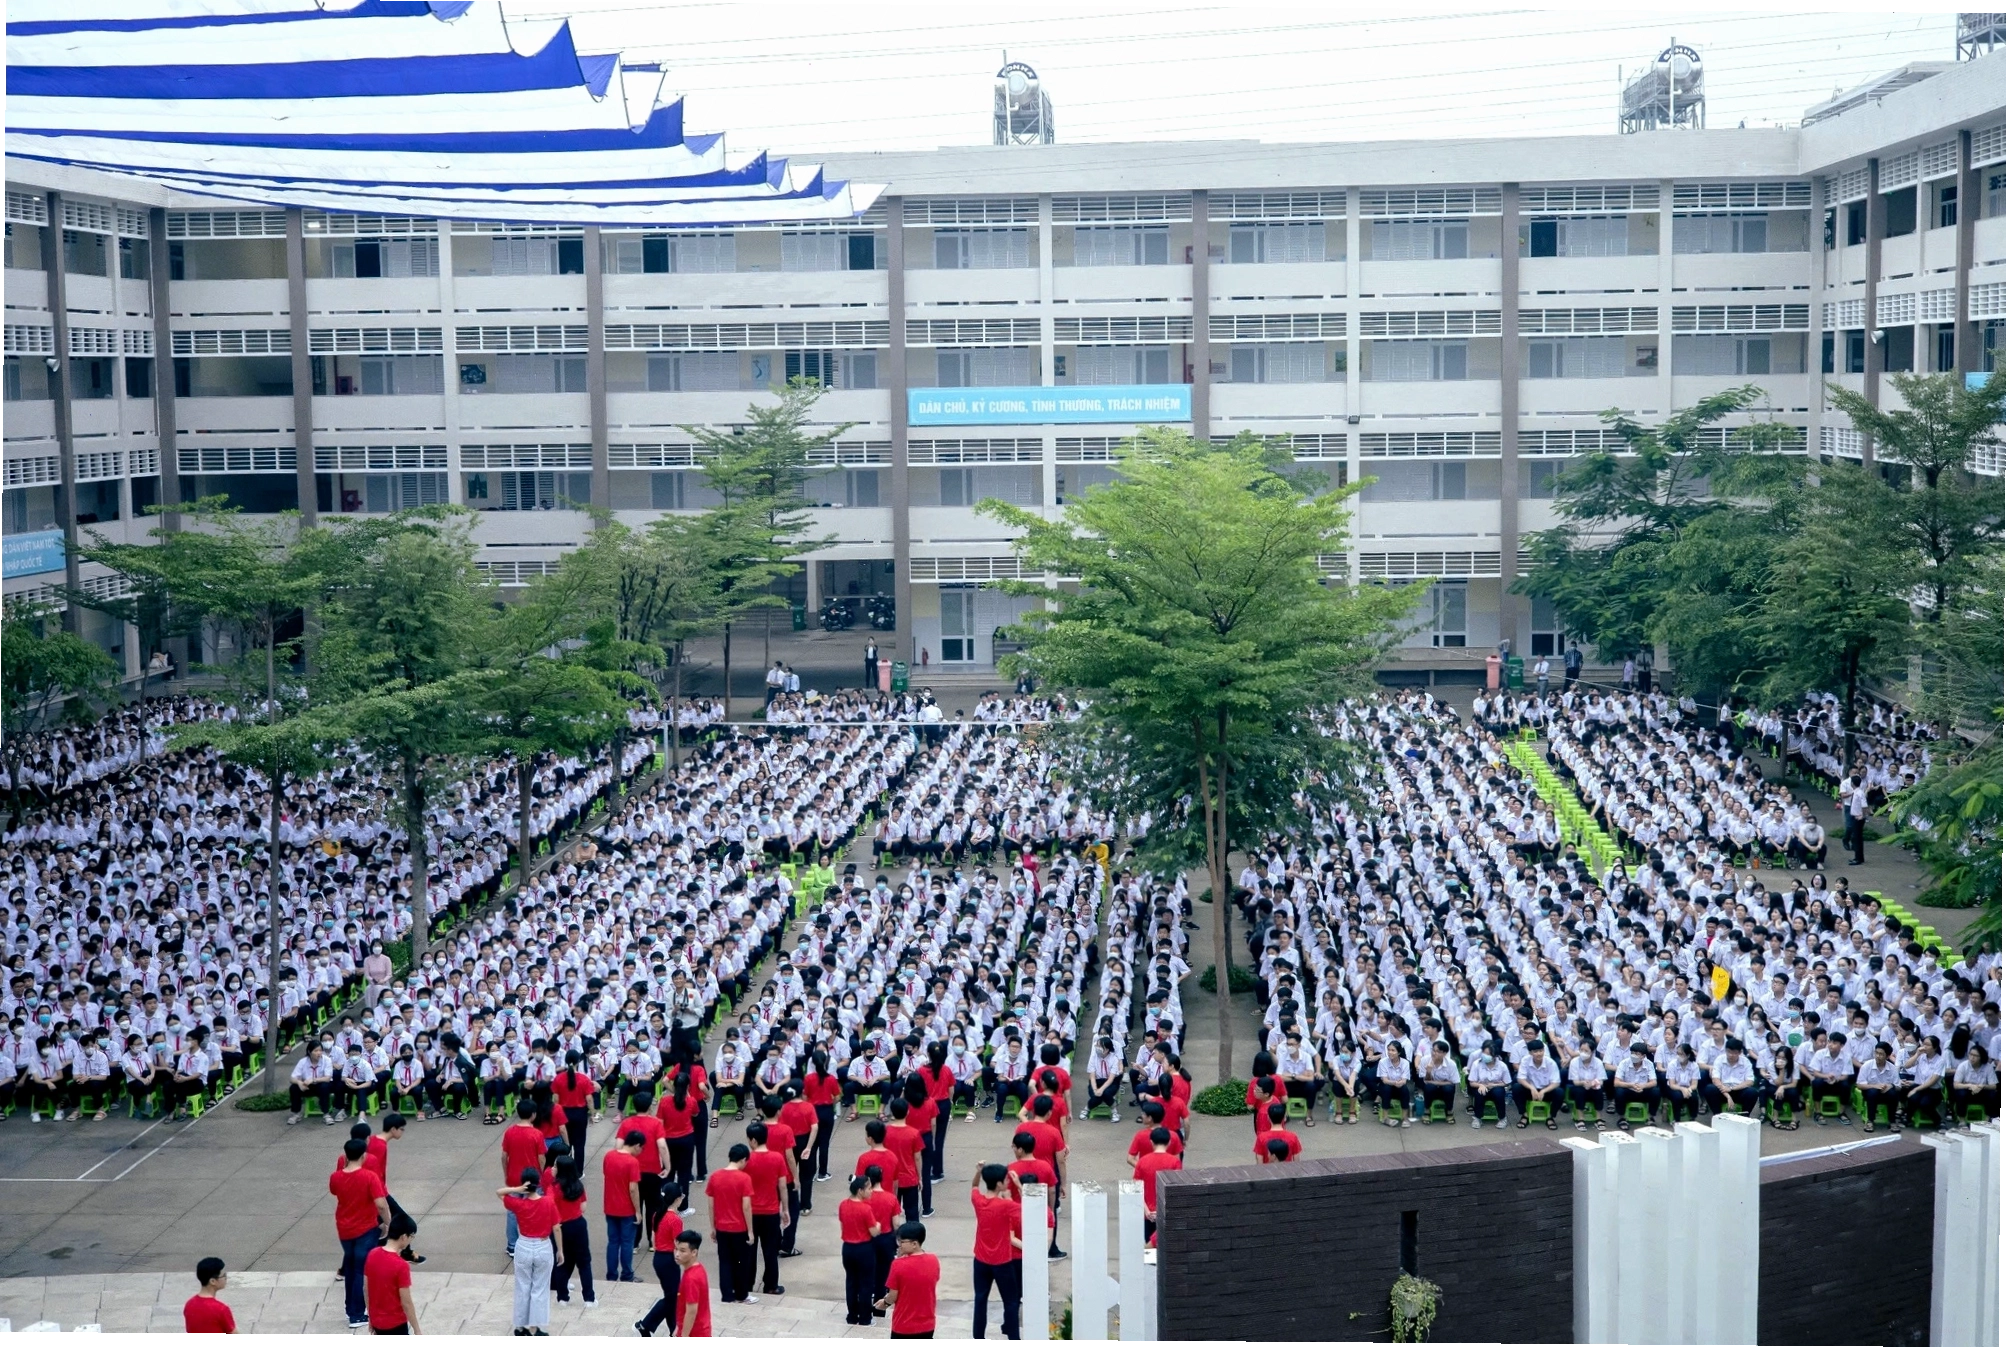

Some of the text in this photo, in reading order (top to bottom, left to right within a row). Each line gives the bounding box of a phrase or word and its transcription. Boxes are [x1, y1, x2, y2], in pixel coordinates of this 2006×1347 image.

[919, 395, 1181, 415] DÂN CHỦ, KỶ CƯƠNG, TÌNH THƯƠNG, TRÁCH NHIỆM
